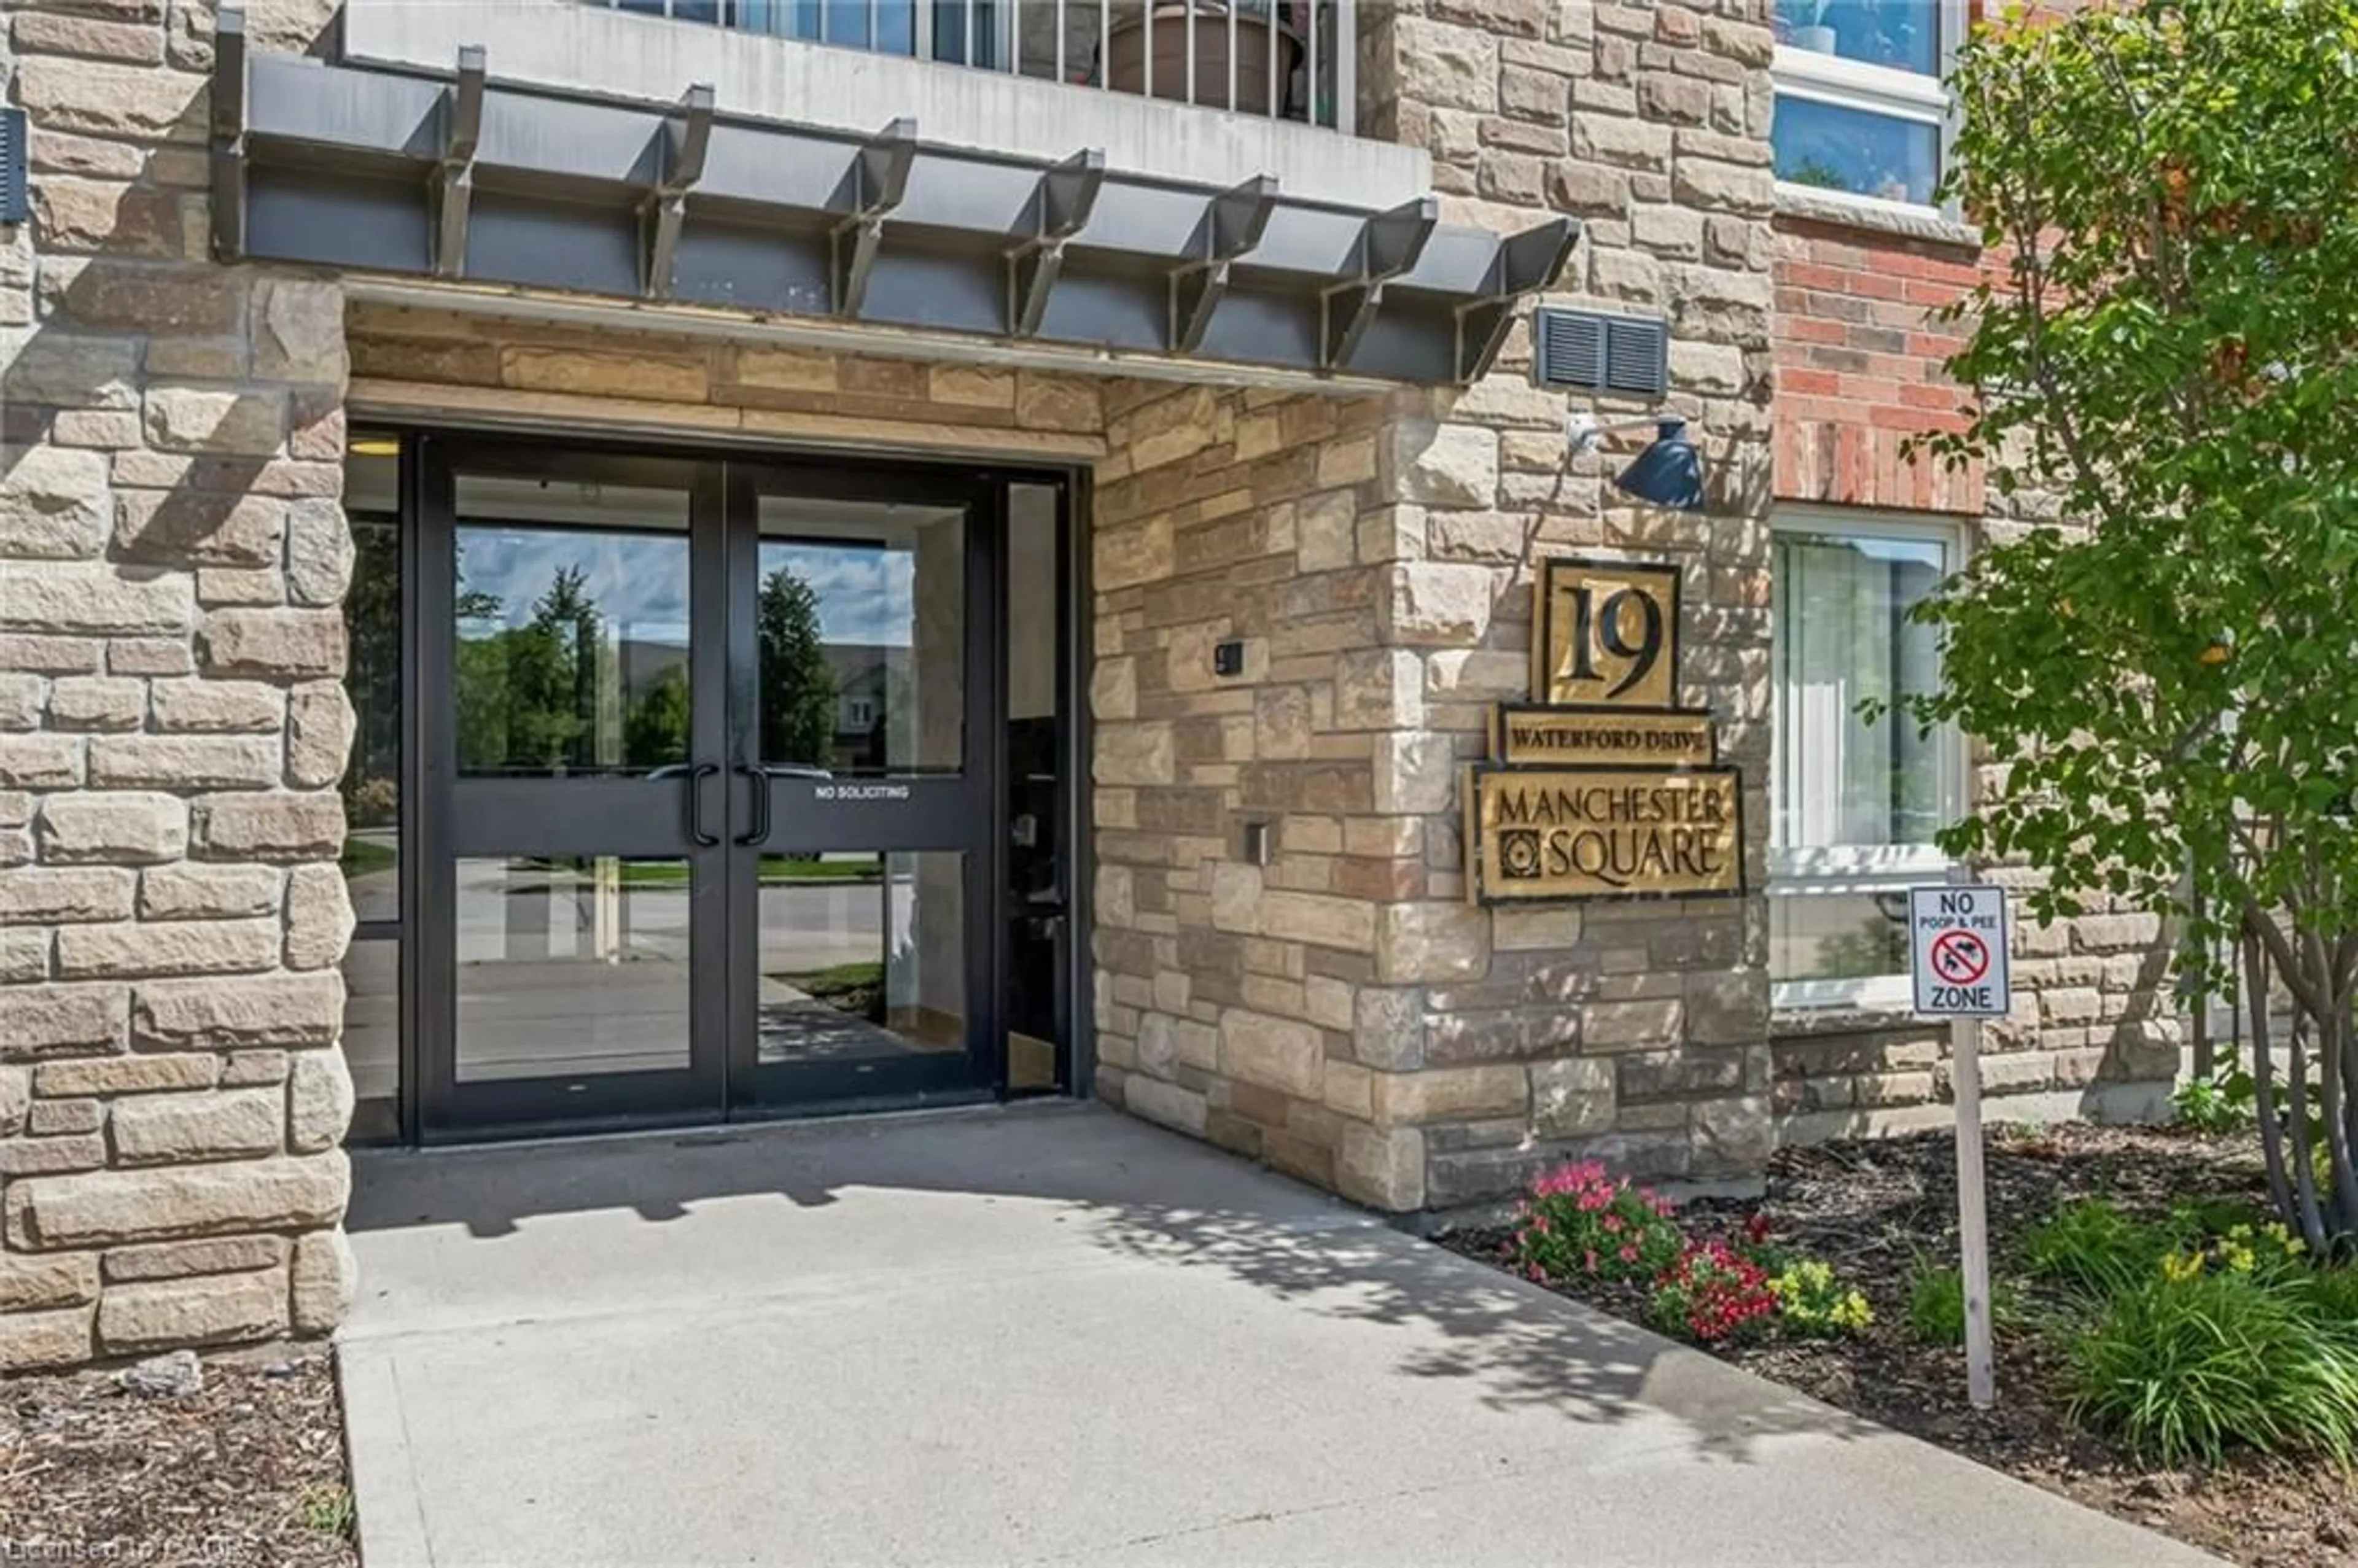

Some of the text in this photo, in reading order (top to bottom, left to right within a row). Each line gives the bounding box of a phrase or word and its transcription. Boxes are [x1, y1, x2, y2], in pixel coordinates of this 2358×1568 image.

[1557, 587, 1663, 699] 19
[1511, 727, 1708, 750] WATERFORD DRIVE
[815, 785, 908, 799] NO SOLICITING
[1498, 788, 1727, 824] MANCHESTER
[1551, 829, 1722, 887] SQUARE
[1940, 893, 1974, 914] NO
[1920, 917, 1955, 929] POOP
[1971, 917, 1996, 928] PEE
[1931, 987, 1991, 1008] ZONE
